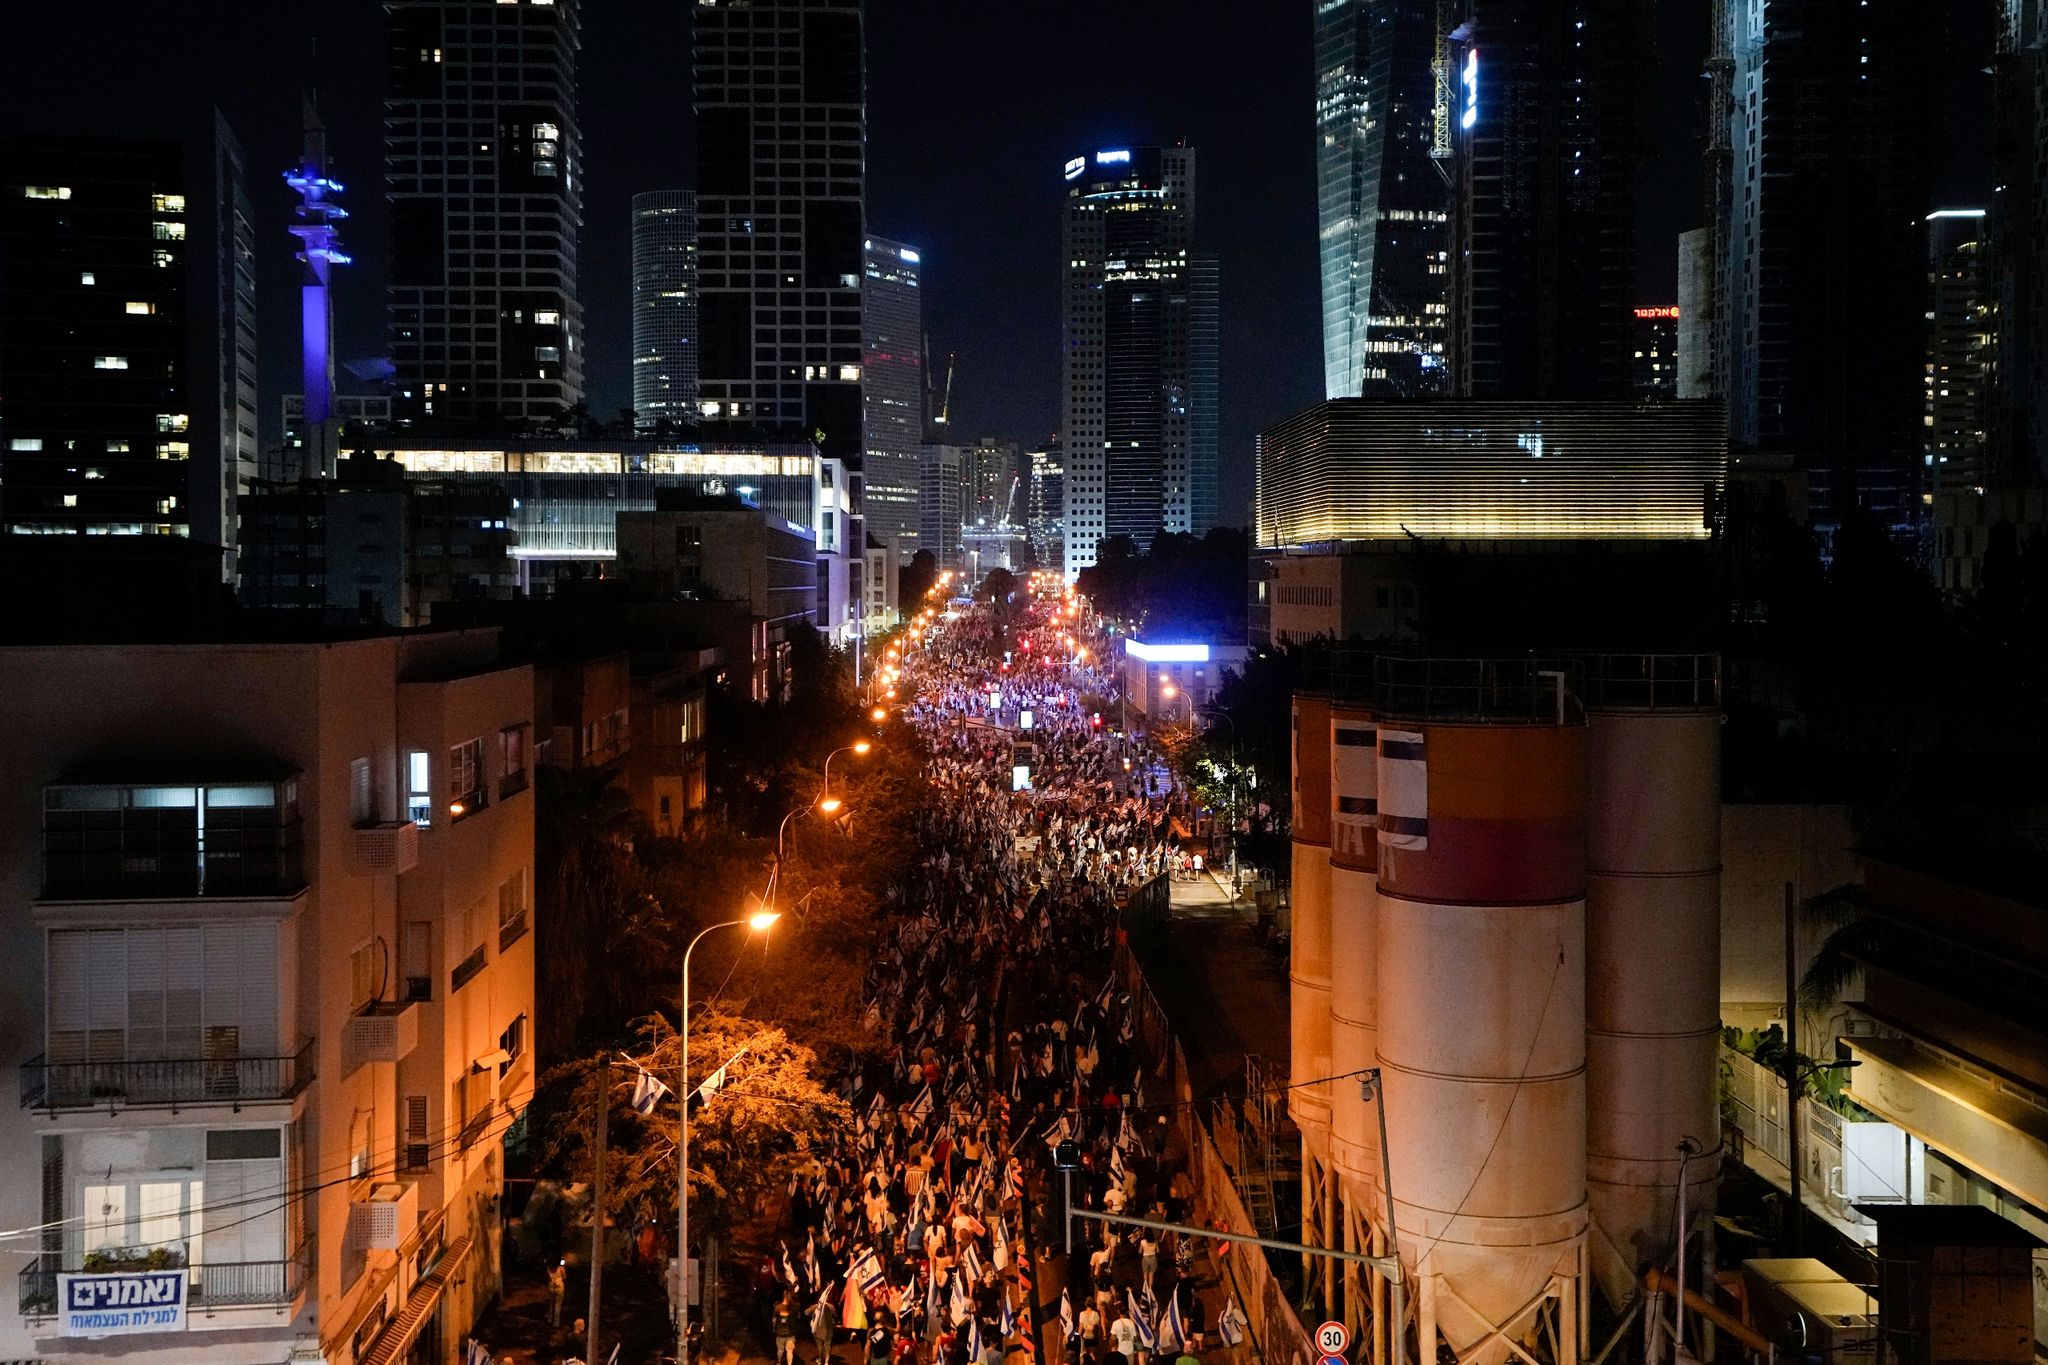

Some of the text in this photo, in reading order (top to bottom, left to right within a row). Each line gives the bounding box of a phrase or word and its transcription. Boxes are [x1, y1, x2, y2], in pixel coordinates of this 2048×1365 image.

[73, 1277, 176, 1307] נאמנים
[70, 1307, 178, 1329] למגילת העצמאות
[1323, 1331, 1342, 1347] 30
